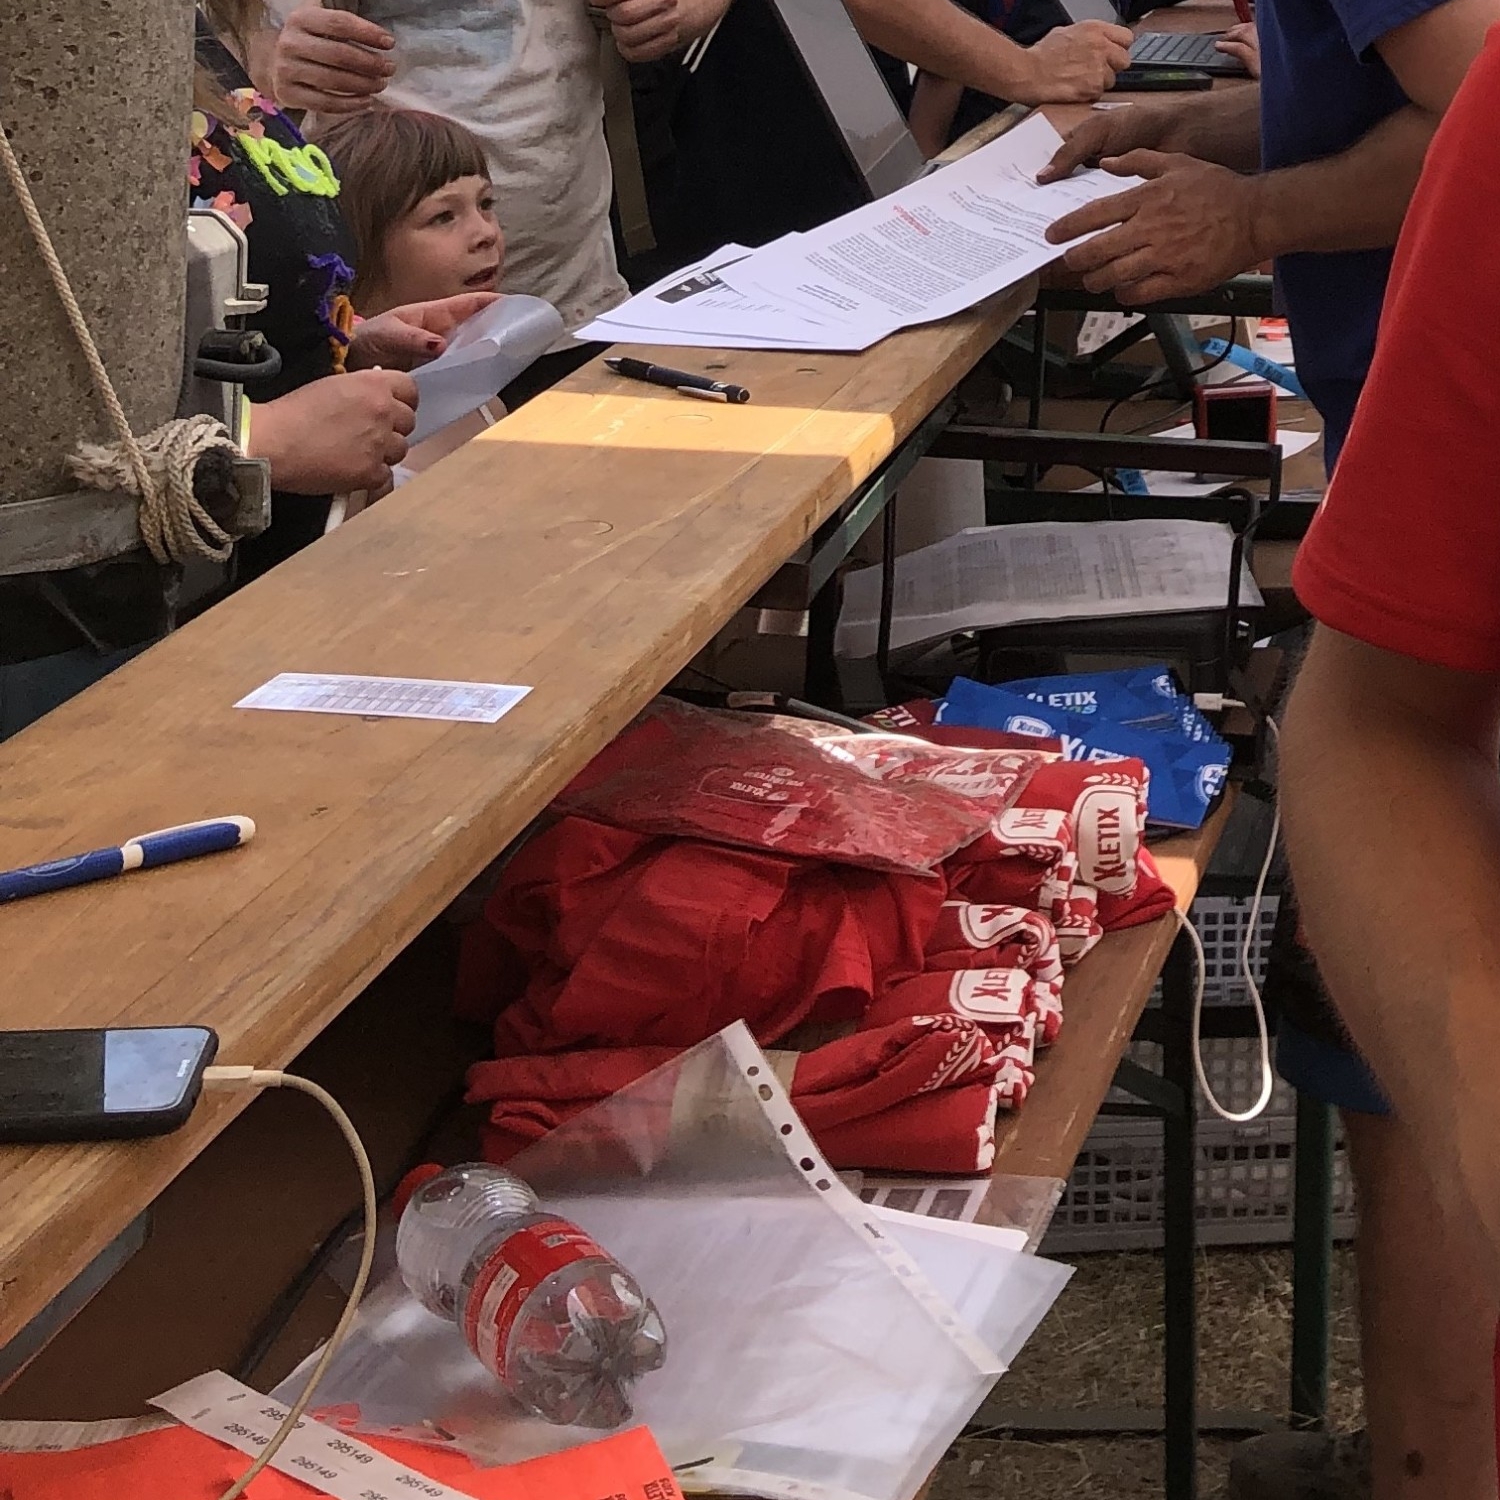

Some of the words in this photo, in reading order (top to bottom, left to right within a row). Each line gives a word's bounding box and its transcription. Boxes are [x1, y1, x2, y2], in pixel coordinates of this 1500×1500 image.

[1093, 806, 1127, 882] XLETIX
[260, 1407, 306, 1430] 2959
[326, 1439, 374, 1464] 295149
[290, 1455, 338, 1479] 295149
[395, 1474, 443, 1497] 295149
